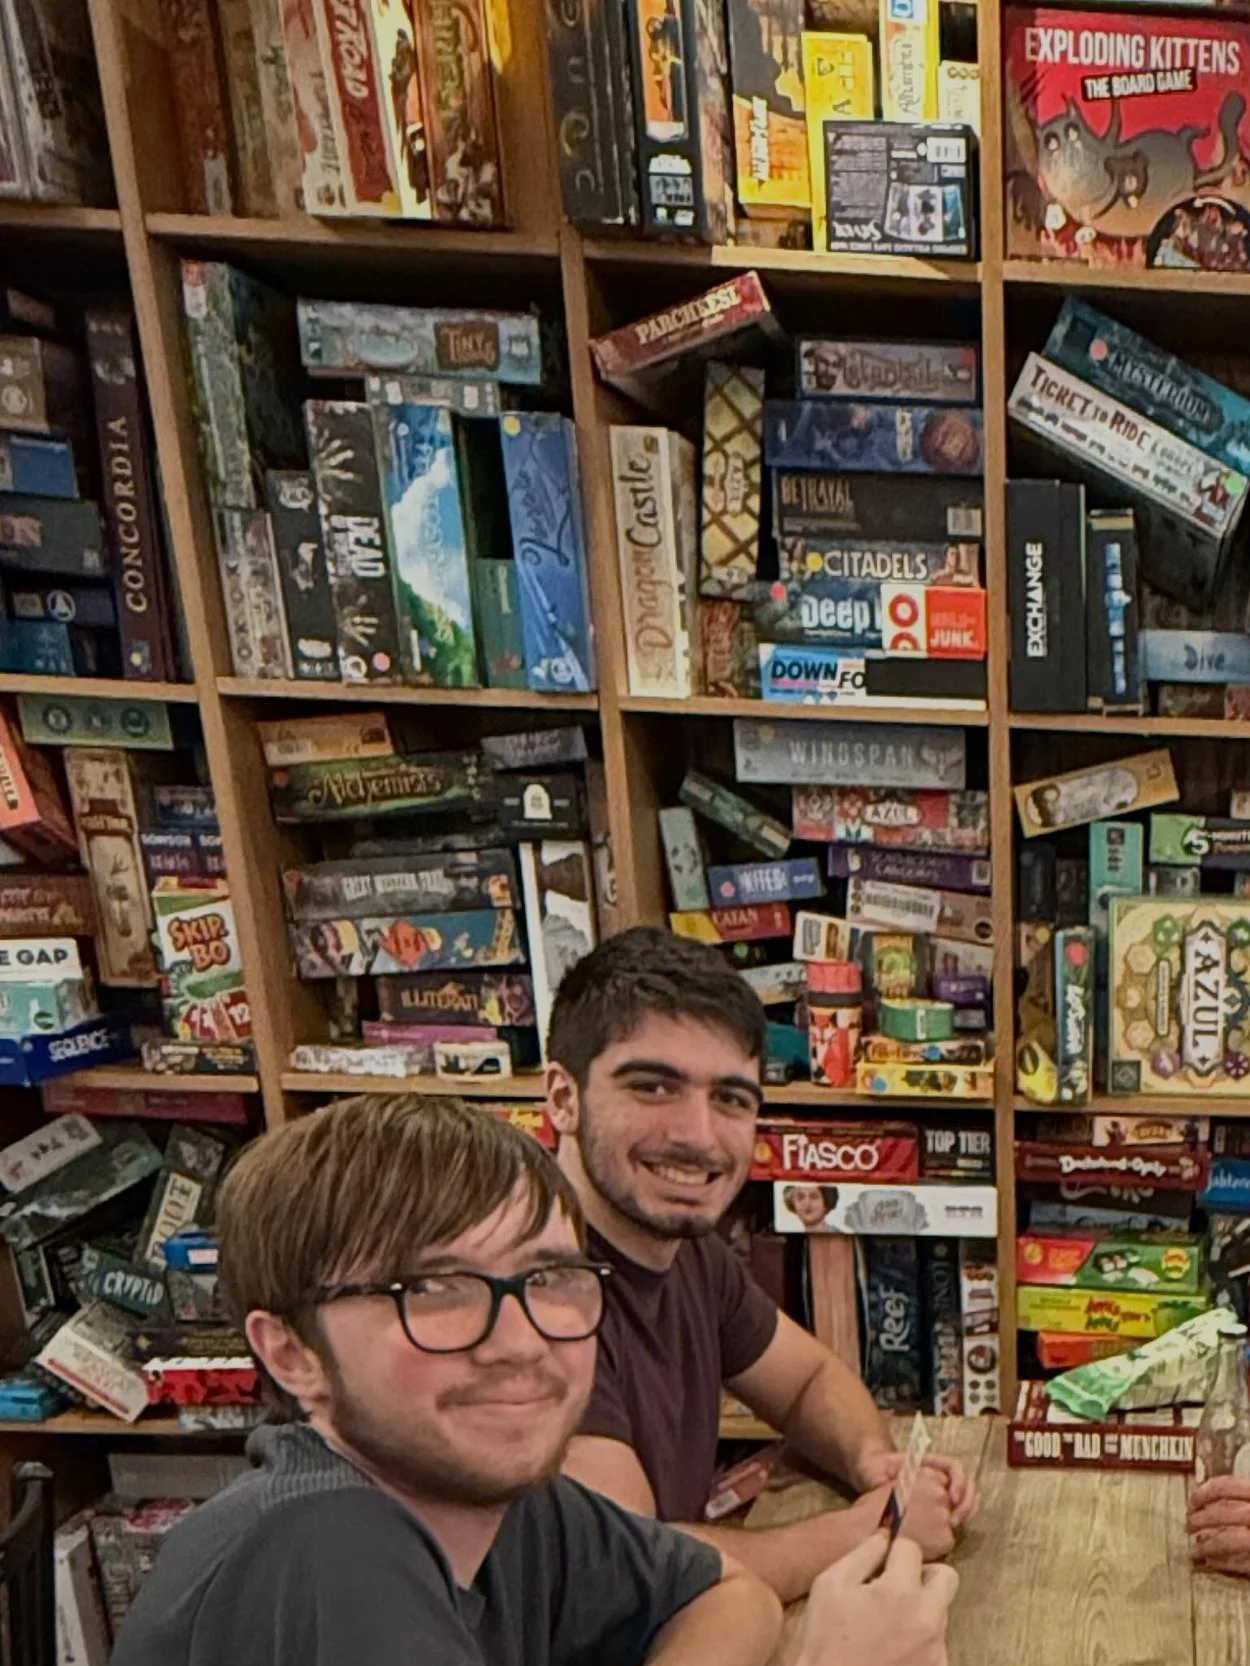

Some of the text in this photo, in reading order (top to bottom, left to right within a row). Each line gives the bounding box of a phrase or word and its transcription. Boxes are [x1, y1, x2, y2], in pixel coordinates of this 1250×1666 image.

[1024, 26, 1241, 76] EXPLODING KITTENS
[1084, 68, 1194, 99] THE BOARD GAME
[634, 283, 742, 345] PARCHEESI
[1029, 363, 1092, 417] TICKET
[1108, 408, 1151, 448] RIDE
[106, 415, 149, 615] CONCORDIA
[617, 455, 664, 551] Castle
[350, 514, 387, 580] DEAD
[823, 549, 929, 581] CITADELS
[801, 595, 870, 638] Deep
[1025, 542, 1044, 659] EXCHANGE
[770, 659, 838, 681] DOWN
[1184, 644, 1226, 671] Dive
[788, 740, 914, 767] WINGSPAN
[711, 909, 759, 927] CATAN
[16, 947, 69, 967] GAP
[1190, 947, 1222, 1048] AZUL
[781, 1133, 880, 1172] FIASCO
[924, 1129, 991, 1155] TOP TIER
[102, 1270, 166, 1304] CRYPTID
[879, 1286, 910, 1351] Reef
[1120, 1434, 1194, 1461] MUNCHKIN
